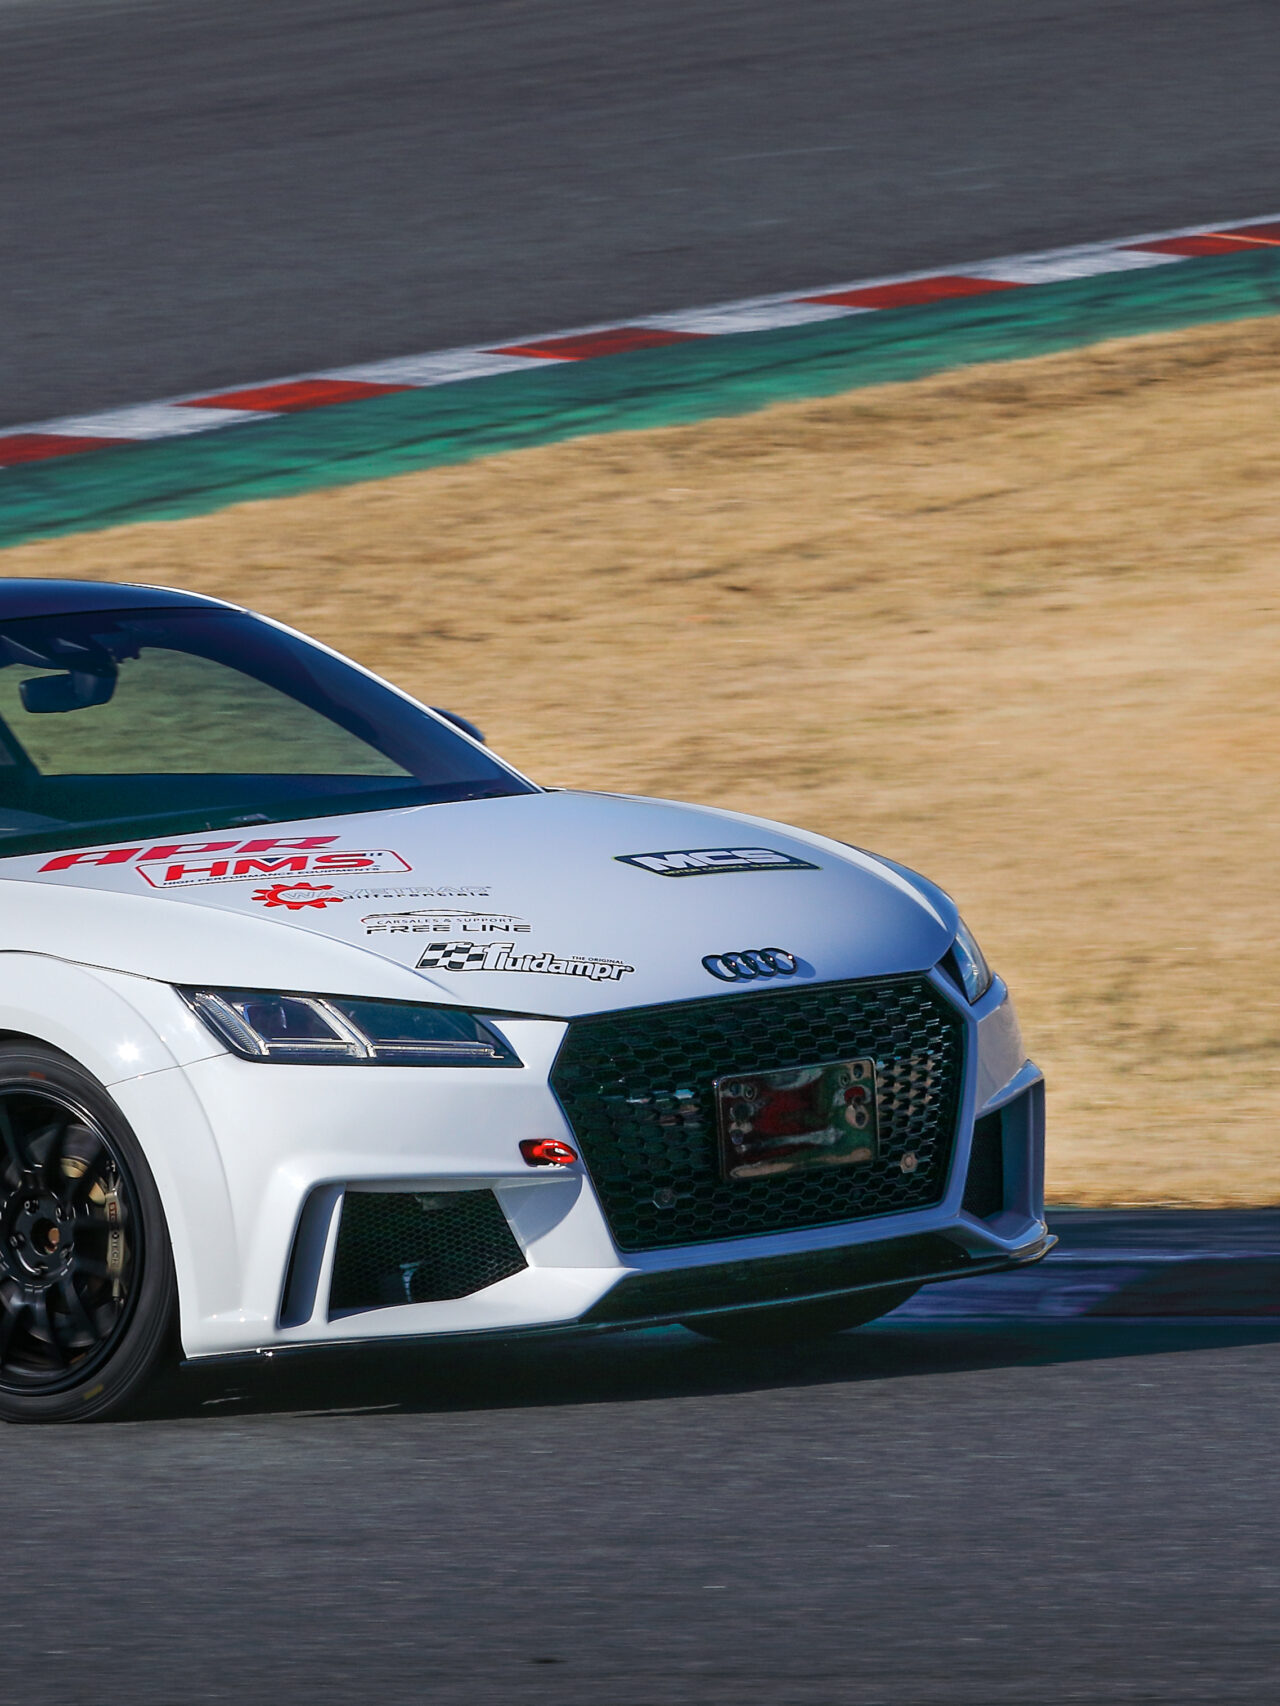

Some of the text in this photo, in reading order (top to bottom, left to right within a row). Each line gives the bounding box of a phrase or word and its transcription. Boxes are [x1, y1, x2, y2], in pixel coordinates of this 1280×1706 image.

[37, 836, 340, 872] APR
[633, 850, 790, 871] MCS
[163, 867, 380, 886] HIGH PERFORMANCE EQUIPMENTS
[165, 853, 377, 881] HMS
[366, 925, 531, 935] FREE LINE
[482, 942, 634, 981] fluidampr
[587, 957, 625, 965] ORIGINAL
